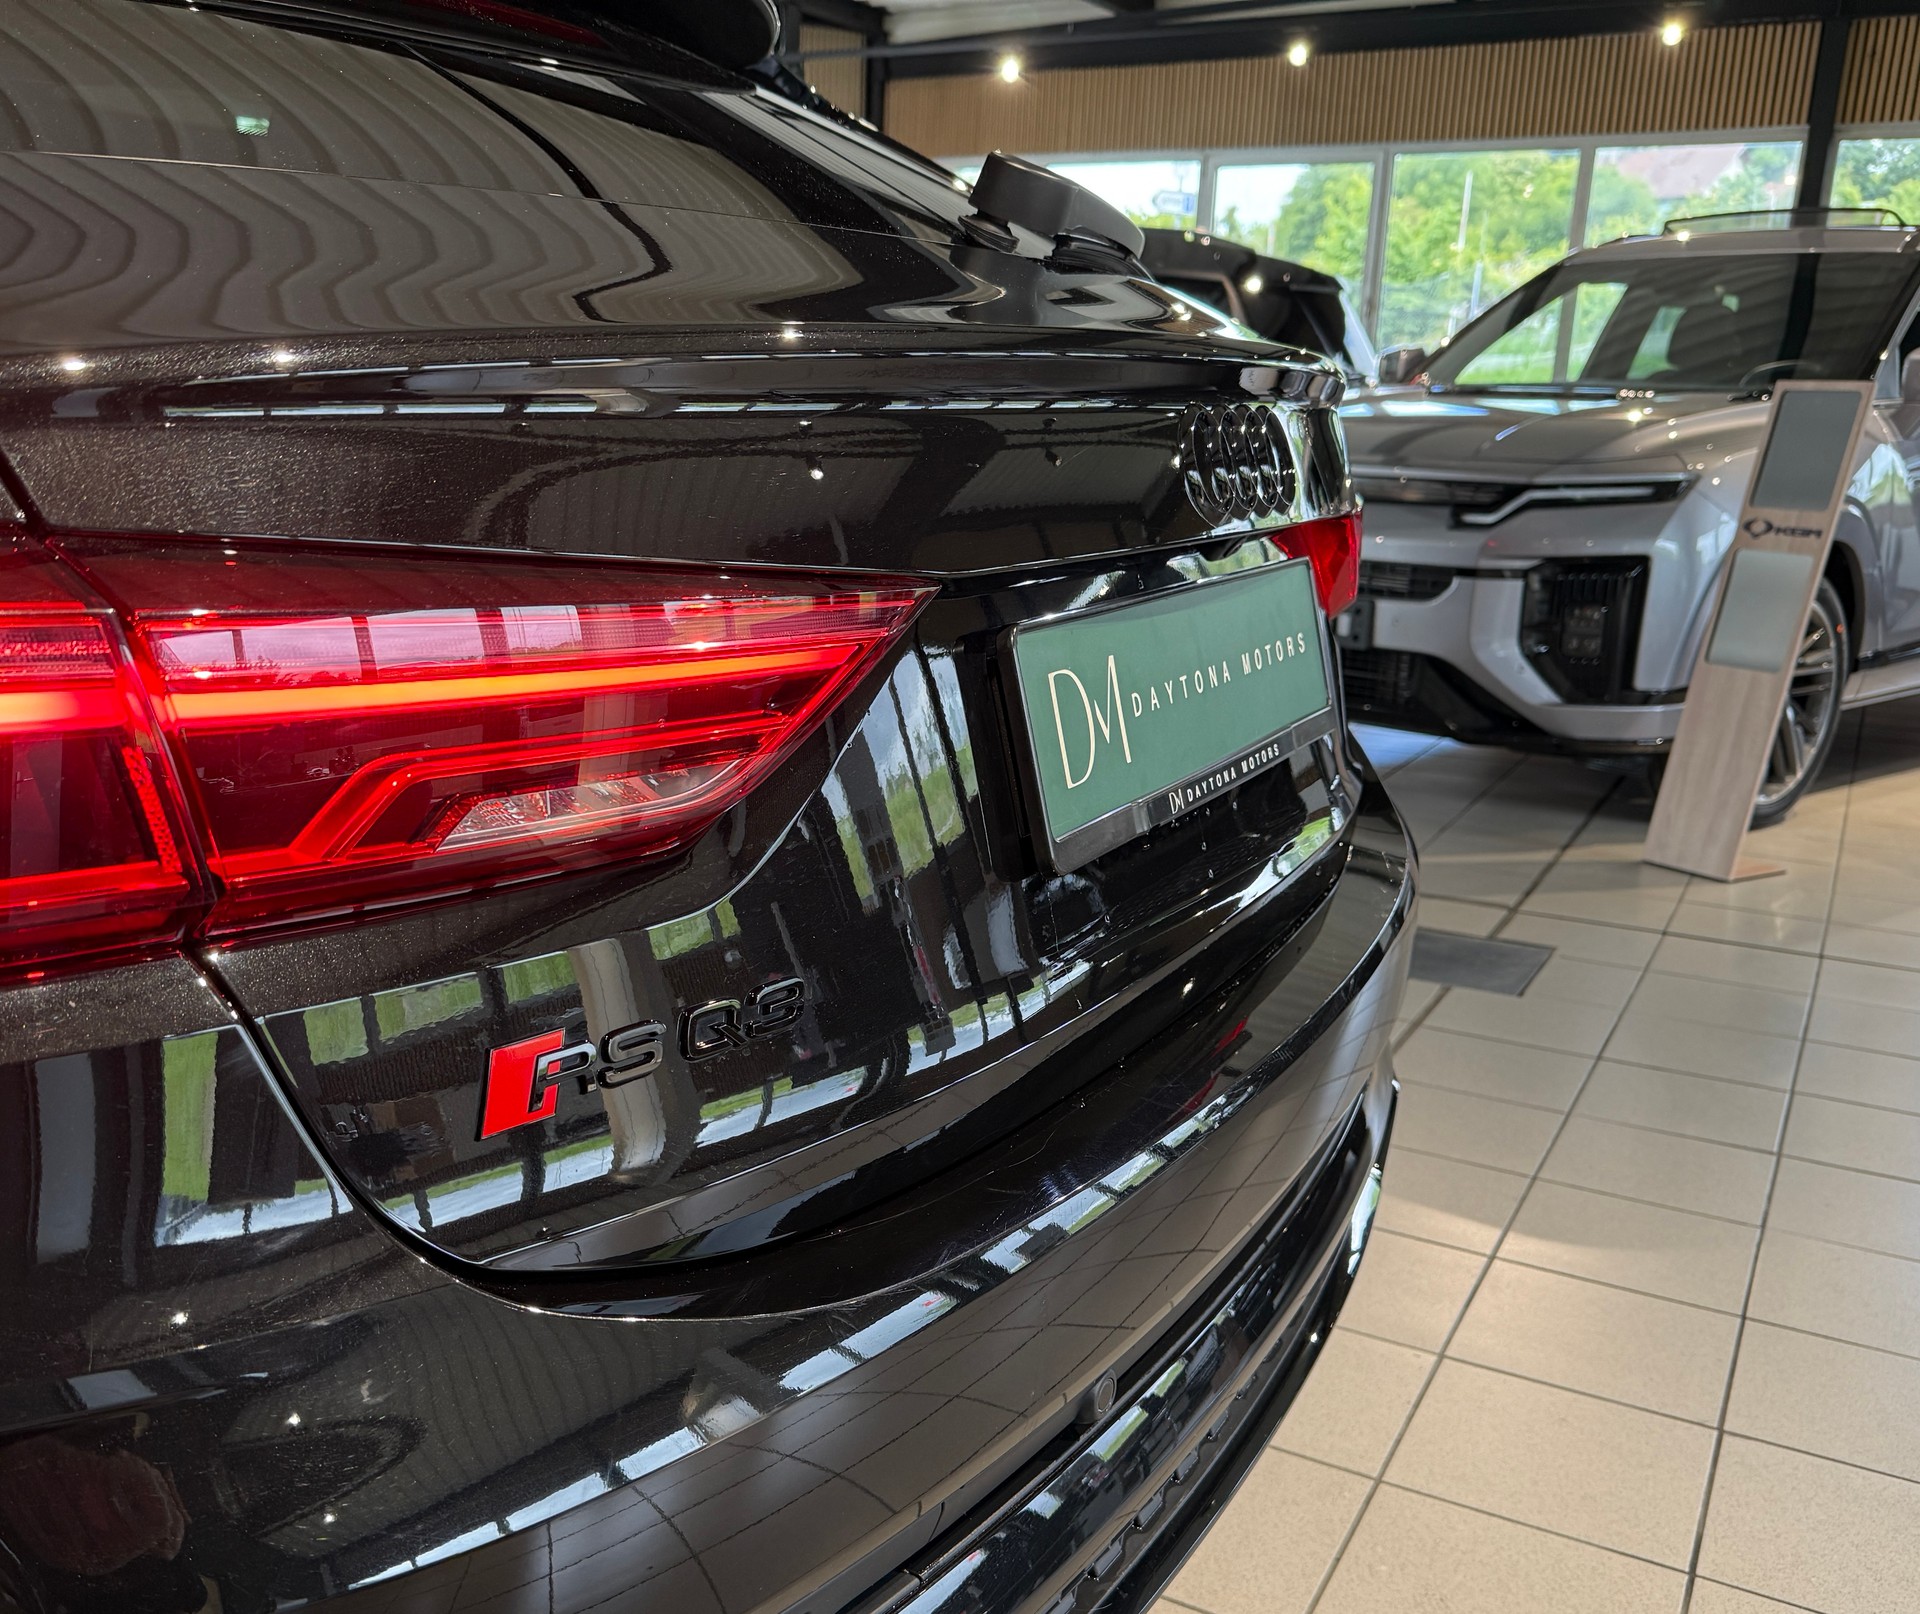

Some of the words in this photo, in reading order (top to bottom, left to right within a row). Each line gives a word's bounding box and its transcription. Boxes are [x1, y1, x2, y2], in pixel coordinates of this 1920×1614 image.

[1131, 661, 1231, 717] DAYTONA
[1241, 632, 1306, 675] MOTORS
[1186, 766, 1237, 802] DAYTONA
[1241, 743, 1280, 773] MOTORS
[524, 1019, 667, 1114] RS
[676, 976, 805, 1063] Q3
